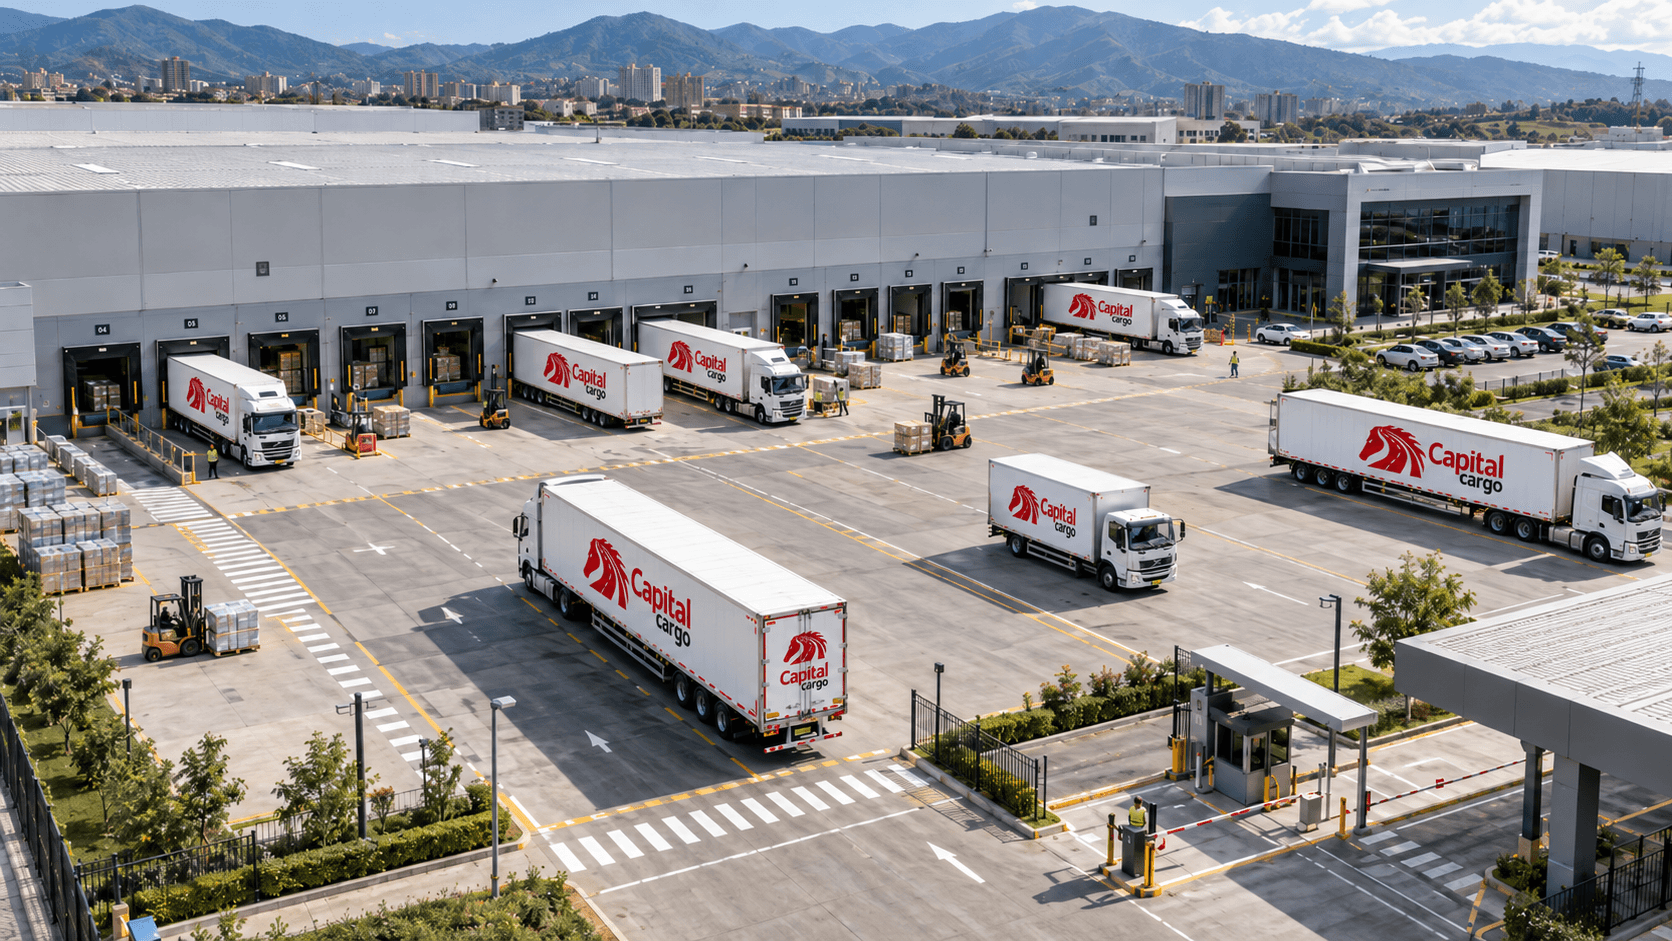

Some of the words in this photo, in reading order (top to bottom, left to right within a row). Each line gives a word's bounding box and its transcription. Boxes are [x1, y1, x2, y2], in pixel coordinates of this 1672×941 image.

[1098, 300, 1133, 317] Capital
[1112, 316, 1133, 327] cargo
[695, 350, 727, 372] Capital
[572, 364, 606, 388] Capital
[706, 369, 727, 383] cargo
[207, 388, 229, 413] Capital
[586, 384, 606, 400] cargo
[216, 411, 230, 427] cargo
[1429, 442, 1504, 478] Capital
[1460, 474, 1502, 494] cargo
[1041, 498, 1076, 525] Capital
[1055, 521, 1076, 538] cargo
[631, 568, 690, 629] Capital
[656, 613, 690, 648] cargo
[780, 661, 828, 685] Capital
[801, 679, 828, 691] cargo
